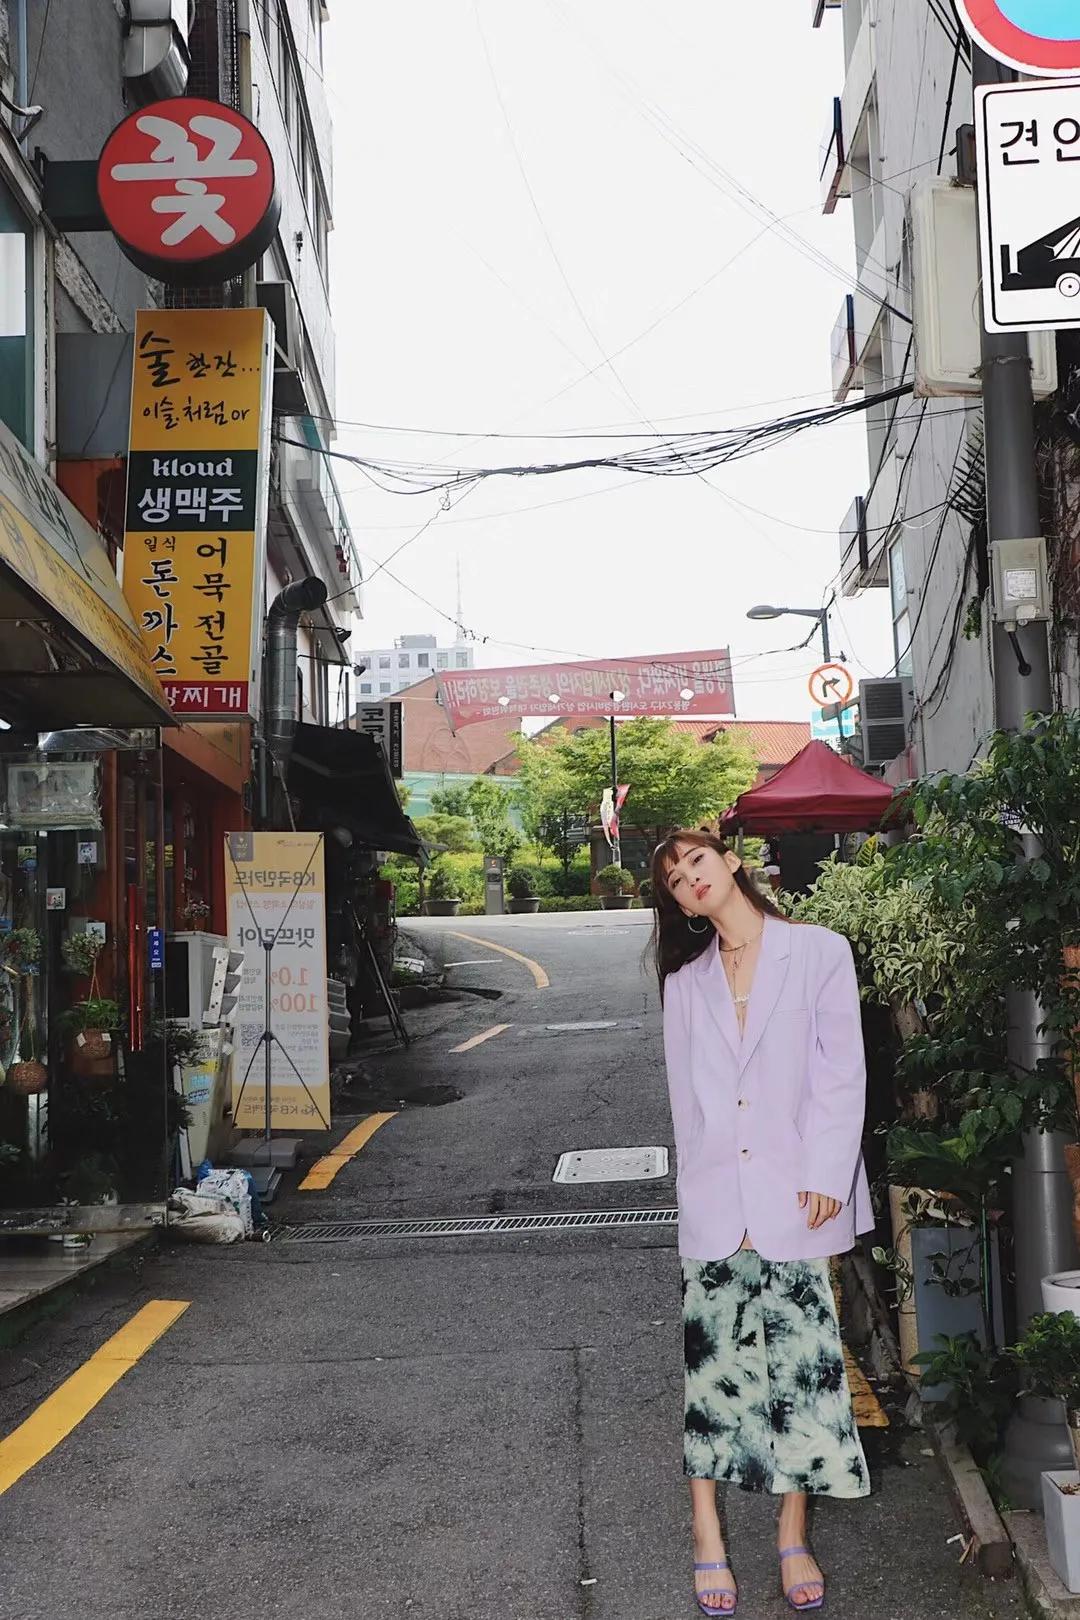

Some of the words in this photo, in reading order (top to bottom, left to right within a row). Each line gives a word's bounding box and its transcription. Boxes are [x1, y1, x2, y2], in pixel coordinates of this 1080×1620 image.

[111, 115, 258, 246] 꽃
[140, 331, 180, 388] 술
[152, 458, 234, 478] Kloud
[138, 487, 244, 524] 생맥주
[144, 536, 176, 553] 일식
[142, 559, 179, 676] 돈까스
[191, 537, 231, 675] 어묵전골
